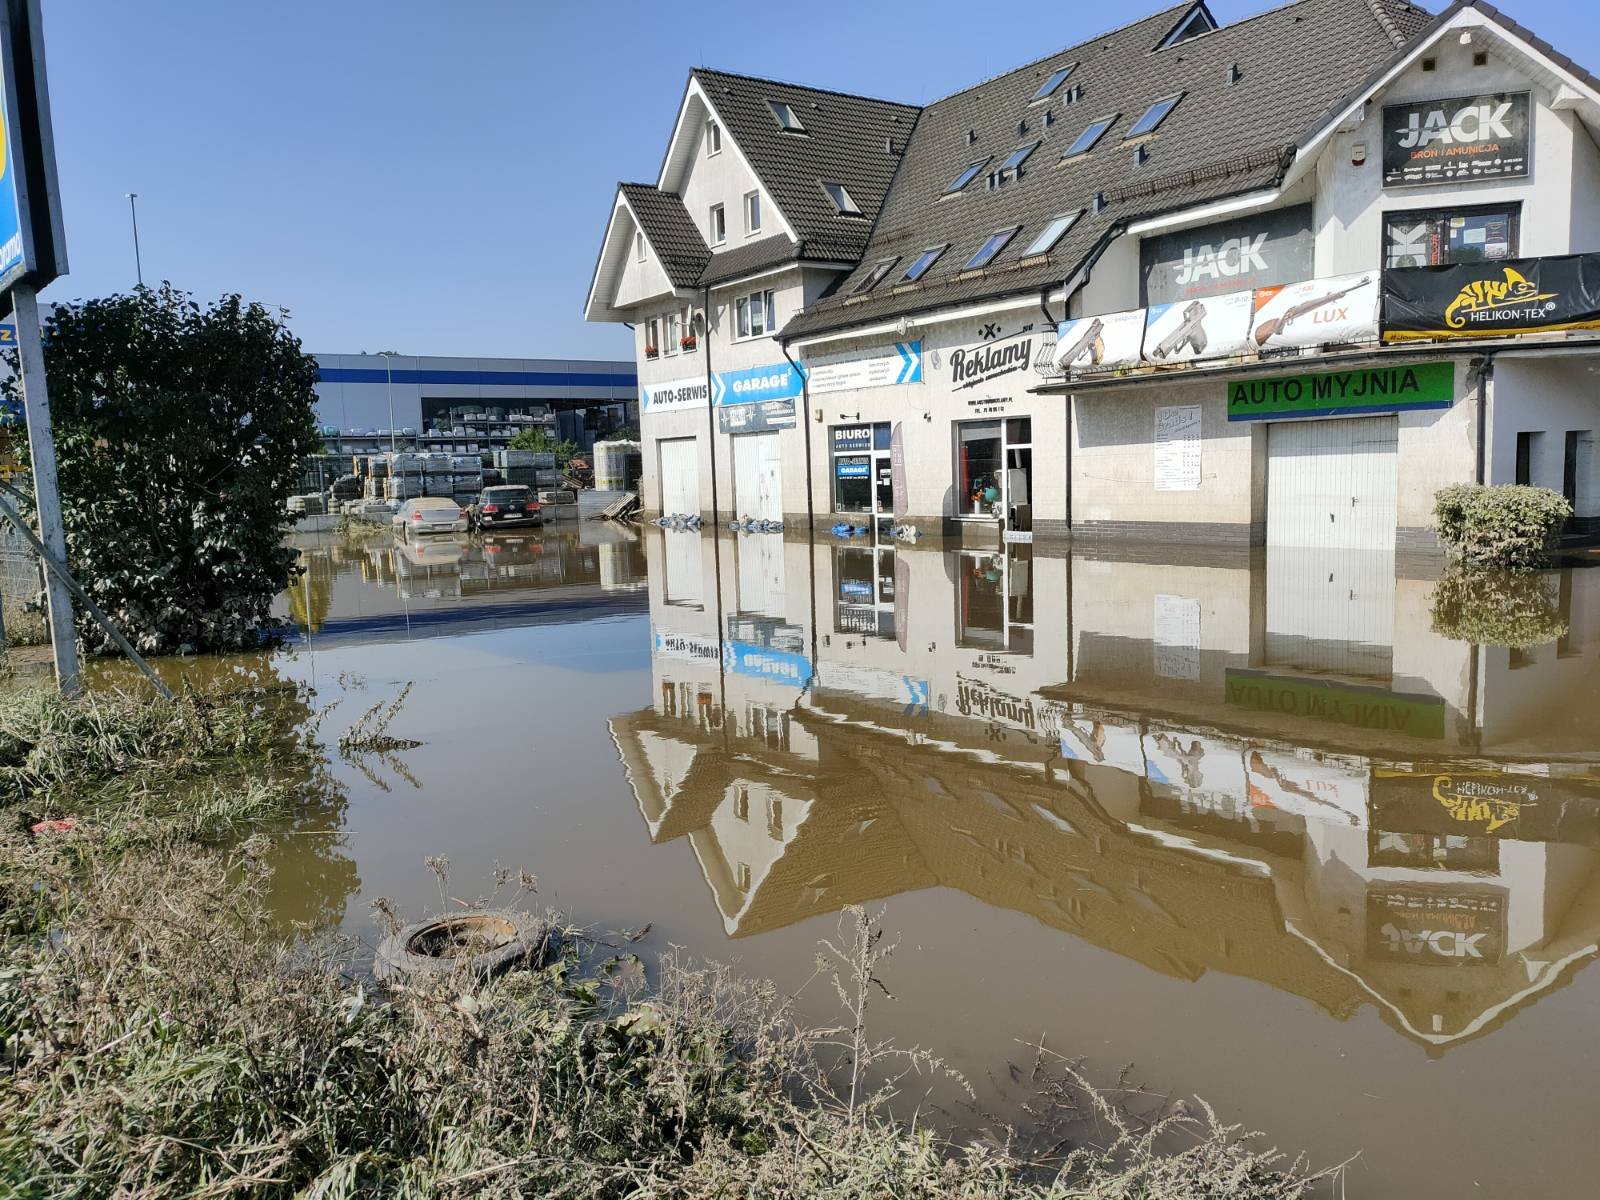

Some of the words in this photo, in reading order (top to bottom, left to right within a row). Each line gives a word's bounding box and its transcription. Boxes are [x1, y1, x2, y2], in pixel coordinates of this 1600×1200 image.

[1397, 102, 1513, 149] JACK
[1446, 143, 1500, 157] AMUNICJA
[1174, 232, 1269, 285] JACK
[1312, 306, 1349, 325] LUX
[949, 338, 1032, 383] Reklamy
[652, 383, 708, 406] AUTO-SERWIS
[1231, 378, 1303, 406] AUTO
[1311, 368, 1420, 400] MYJNIA
[835, 428, 870, 441] BIURO
